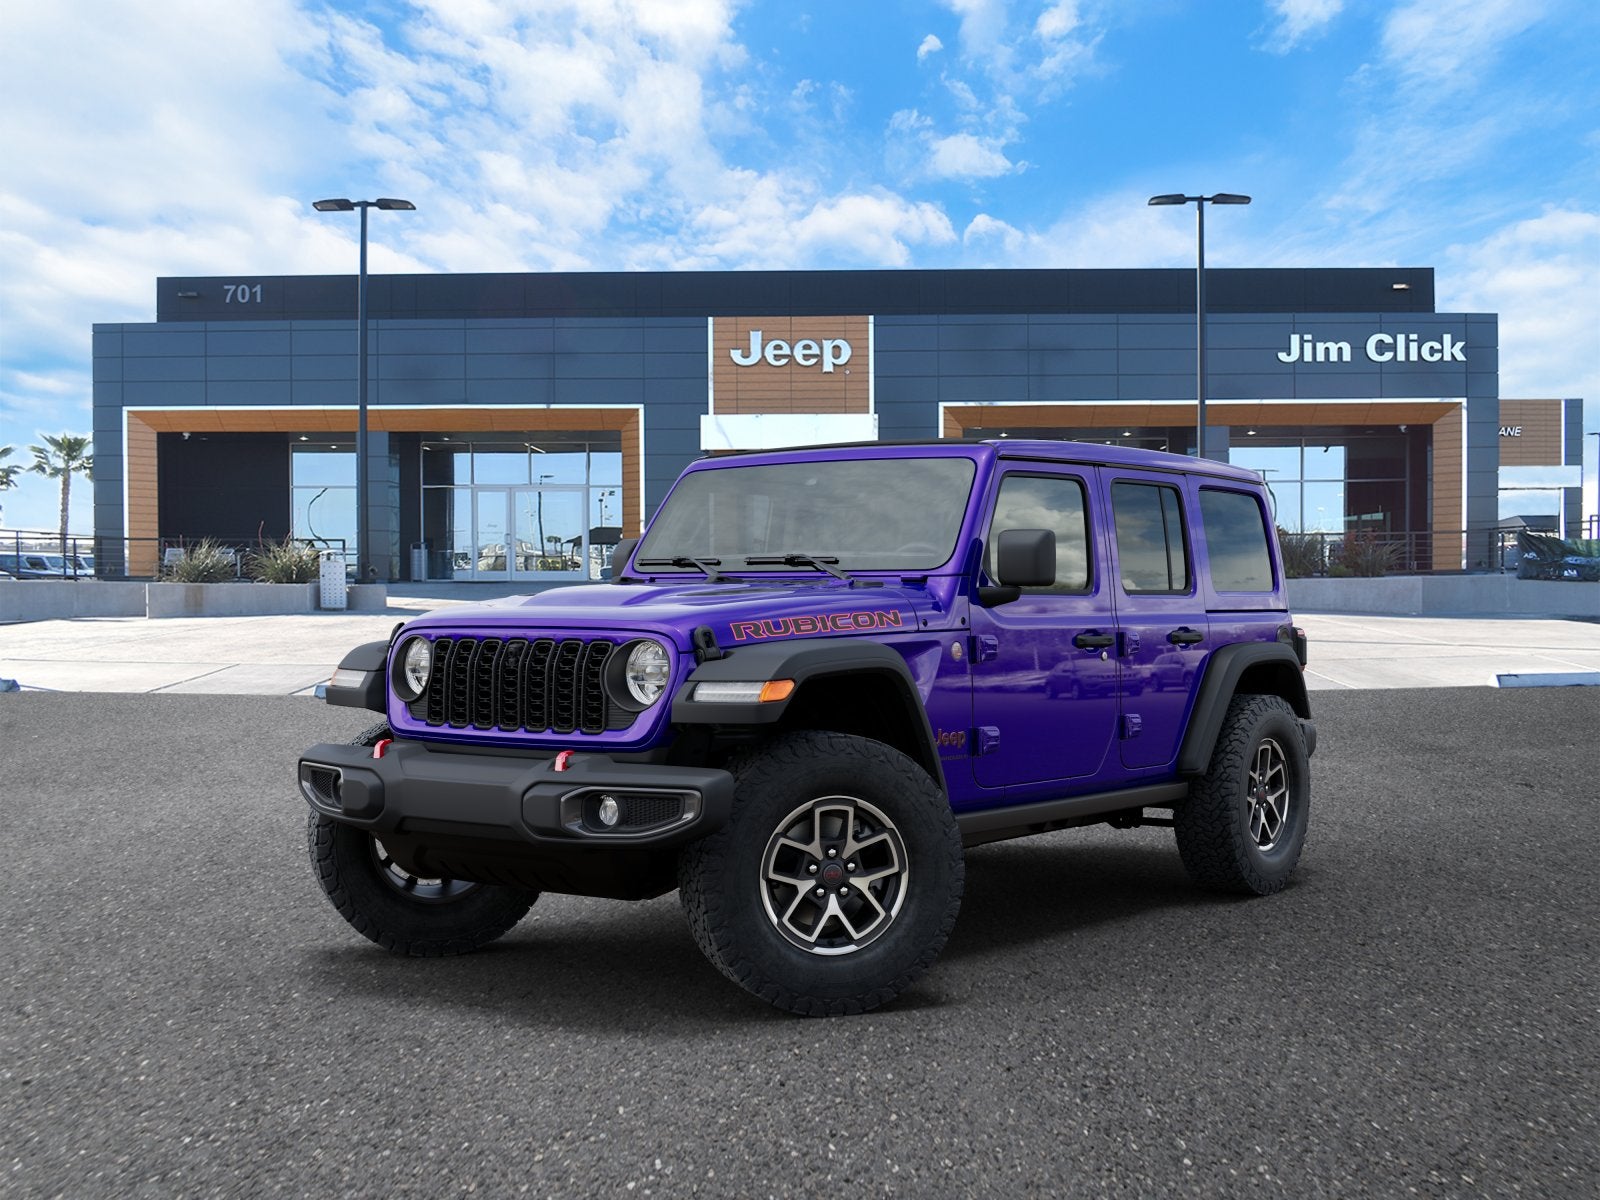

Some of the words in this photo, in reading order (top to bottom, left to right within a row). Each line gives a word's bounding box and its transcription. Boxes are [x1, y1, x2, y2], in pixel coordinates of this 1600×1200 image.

[223, 284, 262, 303] 701
[730, 330, 852, 373] Jeep
[1277, 334, 1351, 363] Jim
[1366, 333, 1467, 362] Click
[730, 610, 902, 641] RUBICON
[936, 728, 966, 748] Jeep
